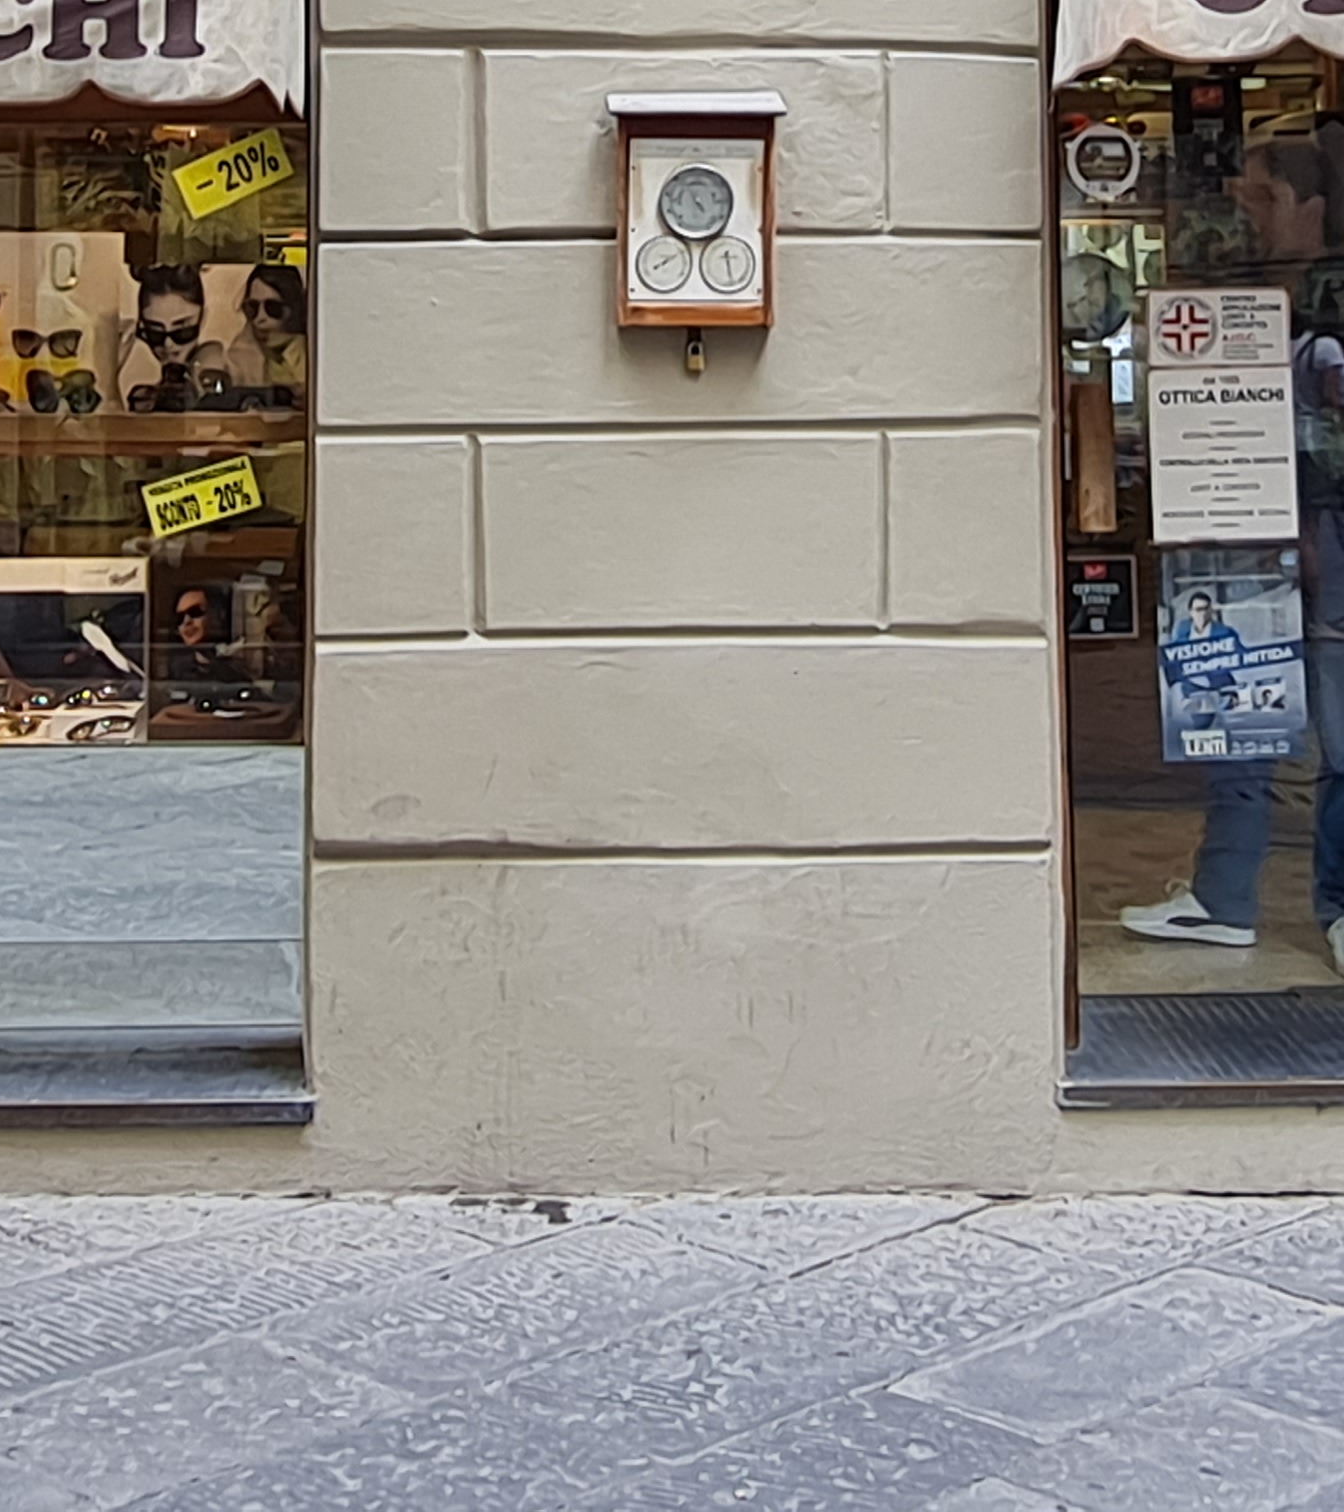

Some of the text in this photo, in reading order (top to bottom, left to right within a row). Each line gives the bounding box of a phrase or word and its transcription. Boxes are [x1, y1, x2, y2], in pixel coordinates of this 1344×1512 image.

[1158, 387, 1285, 406] OTTICA BIANCHI
[1163, 637, 1236, 662] VISIONE
